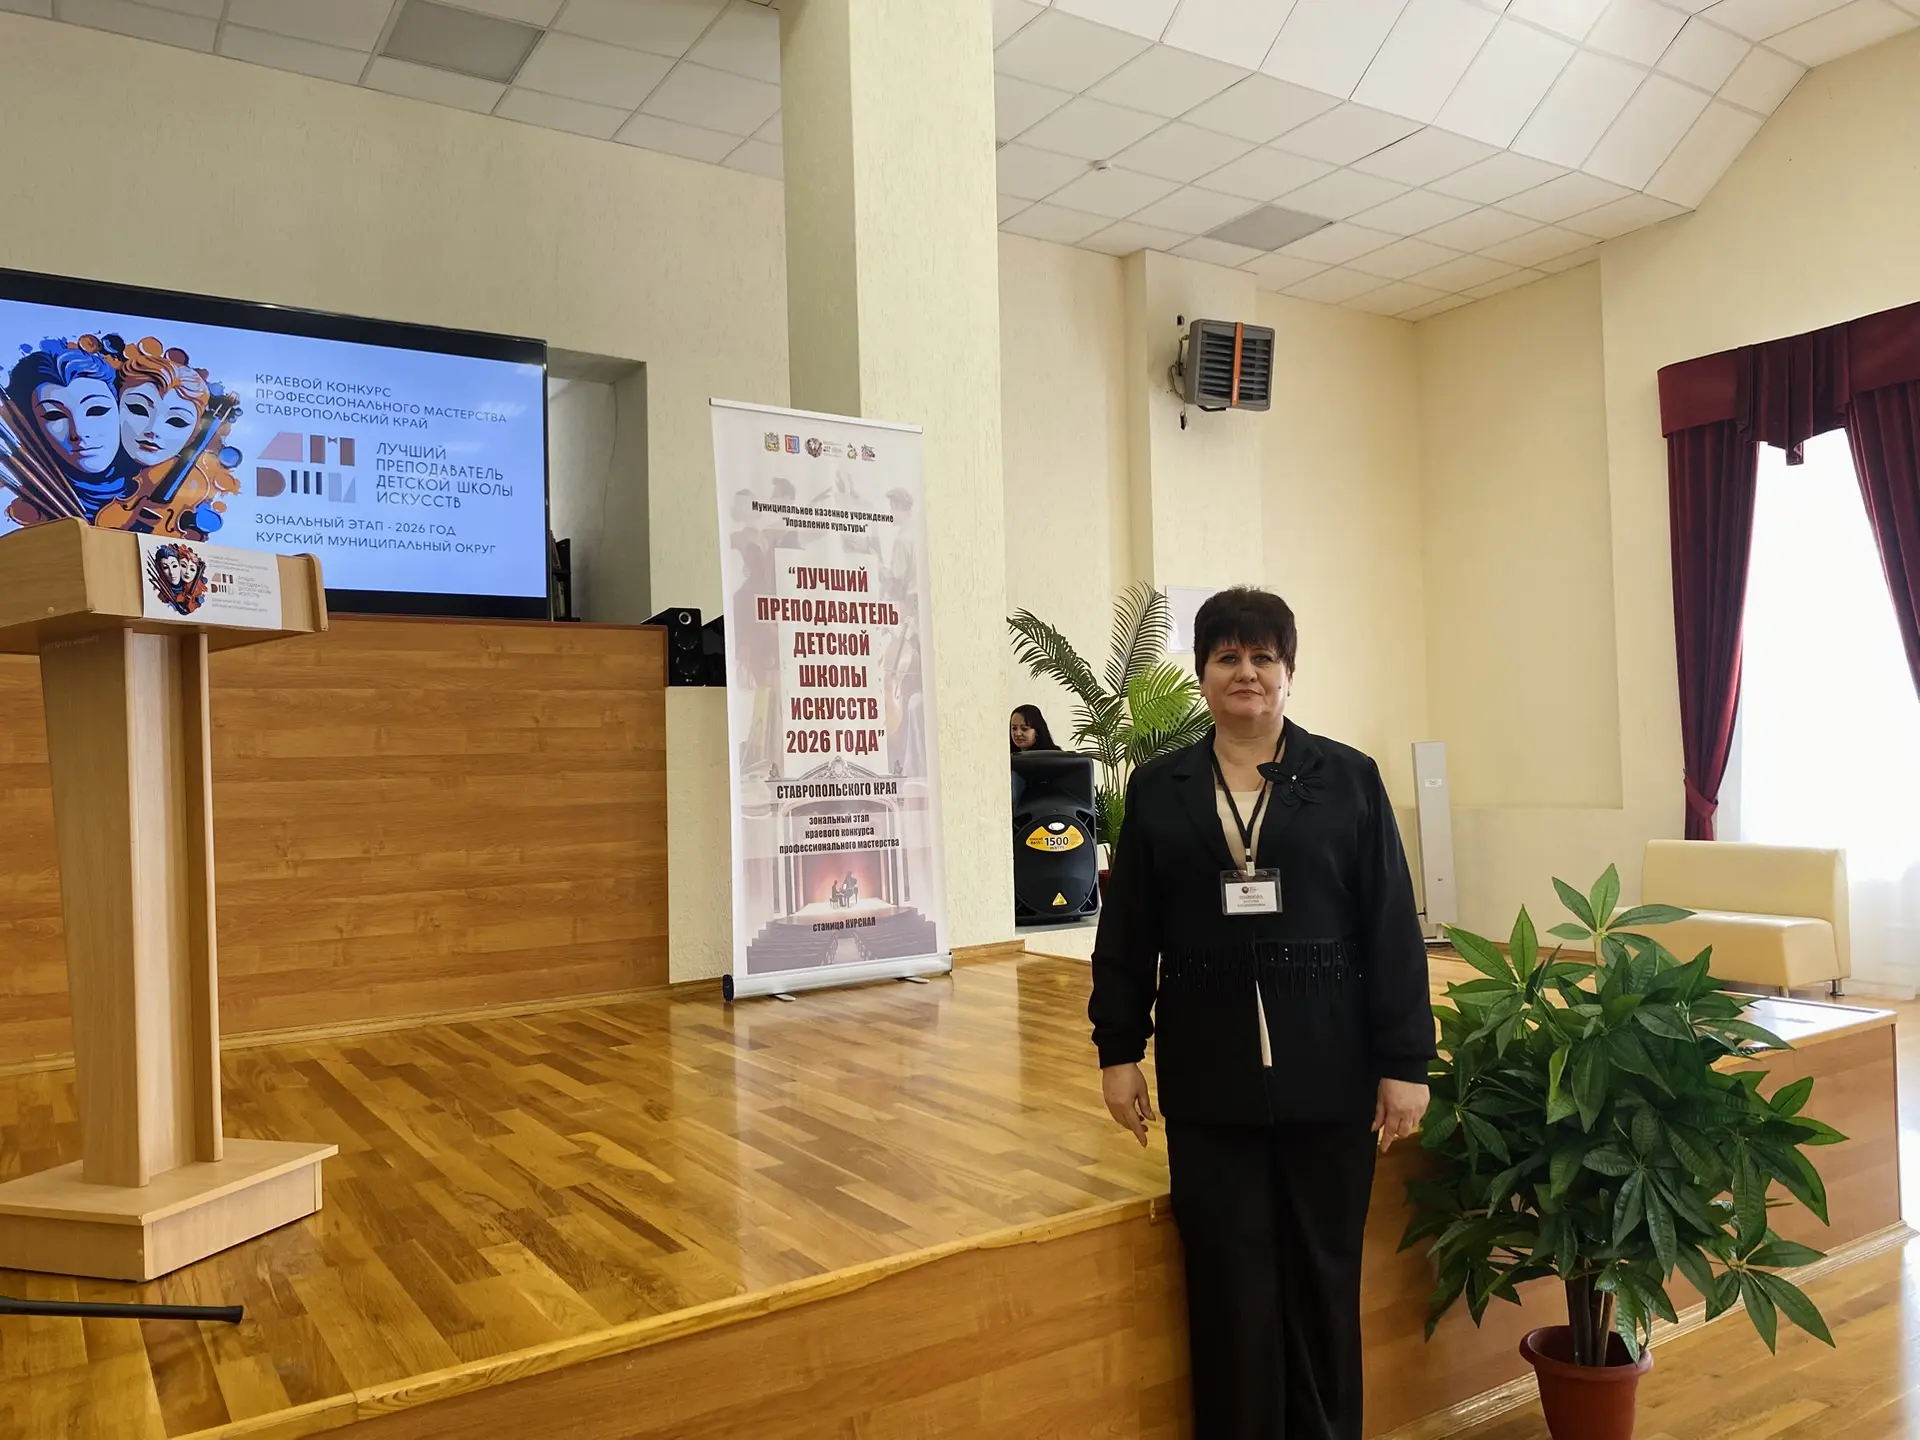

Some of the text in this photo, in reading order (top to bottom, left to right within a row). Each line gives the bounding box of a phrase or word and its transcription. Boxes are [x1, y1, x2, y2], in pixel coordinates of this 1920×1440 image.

[255, 373, 392, 397] КРАЕВОЙ КОНКУРС
[255, 388, 507, 423] ПРОФЕССИОНАЛЬНОГО МАСТЕРСТВА
[255, 403, 428, 429] СТАВРОПОЛЬСКИЙ КРАЙ
[376, 442, 447, 460] ЛУЧШИЙ
[376, 458, 504, 481] ПРЕПОДАВАТЕЛЬ
[376, 474, 513, 497] ДЕТСКОЙ ШКОЛЫ
[377, 491, 462, 509] ИСКУССТВ
[752, 501, 894, 523] Муниципальное казенное учреждение
[255, 513, 344, 529] ЗОНАЛЬНЫЙ
[348, 519, 384, 531] ЭТАП
[395, 522, 426, 534] 2026
[429, 525, 457, 537] ГОД
[256, 531, 497, 555] КУРСКИЙ МУНИЦИПАЛЬНЫЙ ОКРУГ
[788, 566, 869, 593] “ЛУЧШИЙ
[757, 597, 899, 626] ПРЕПОДАВАТЕЛЬ
[793, 629, 870, 658] ДЕТСКОЙ
[799, 664, 868, 688] ШКОЛЫ
[790, 697, 879, 721] ИСКУССТВ
[786, 729, 885, 756] 2026 ГОДА”
[776, 781, 898, 800] СТАВРОПОЛЬСКОГО КРАЯ
[808, 813, 870, 826] зональный этап
[805, 826, 875, 840] краевого конкурса
[1044, 836, 1069, 846] 1500
[779, 838, 900, 855] профессионального мастерства
[812, 916, 876, 933] станица КУРСКАЯ
